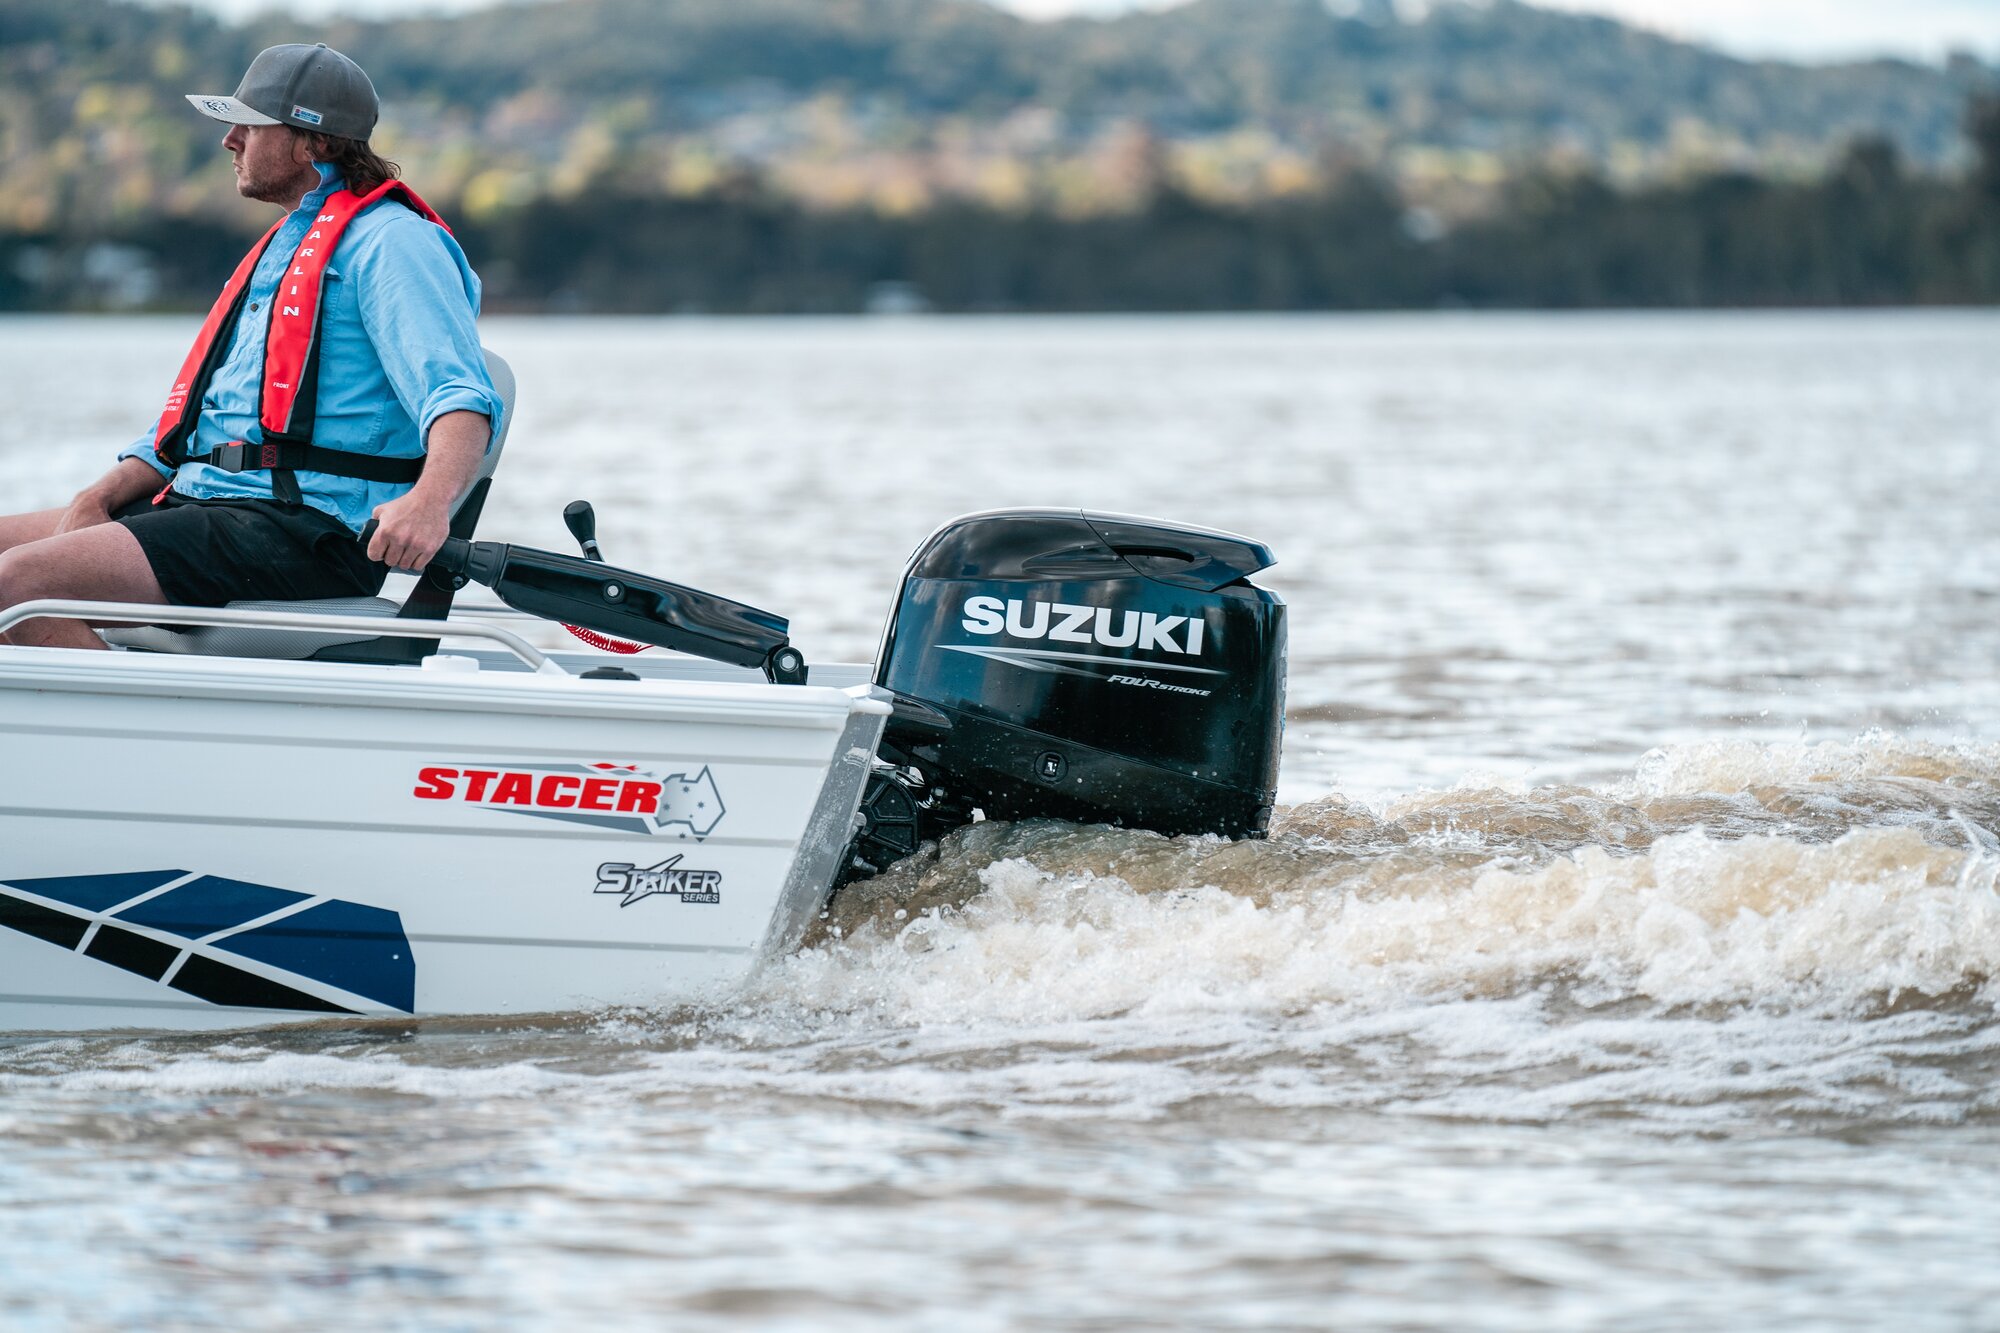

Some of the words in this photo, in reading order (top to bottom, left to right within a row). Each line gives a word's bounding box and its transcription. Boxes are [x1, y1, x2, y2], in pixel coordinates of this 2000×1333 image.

[283, 214, 335, 317] MARLIN
[272, 381, 290, 389] FRONT
[962, 595, 1205, 656] SUZUKI
[413, 767, 663, 814] STACER
[593, 861, 722, 894] STRIKER
[682, 893, 720, 903] SERIES
